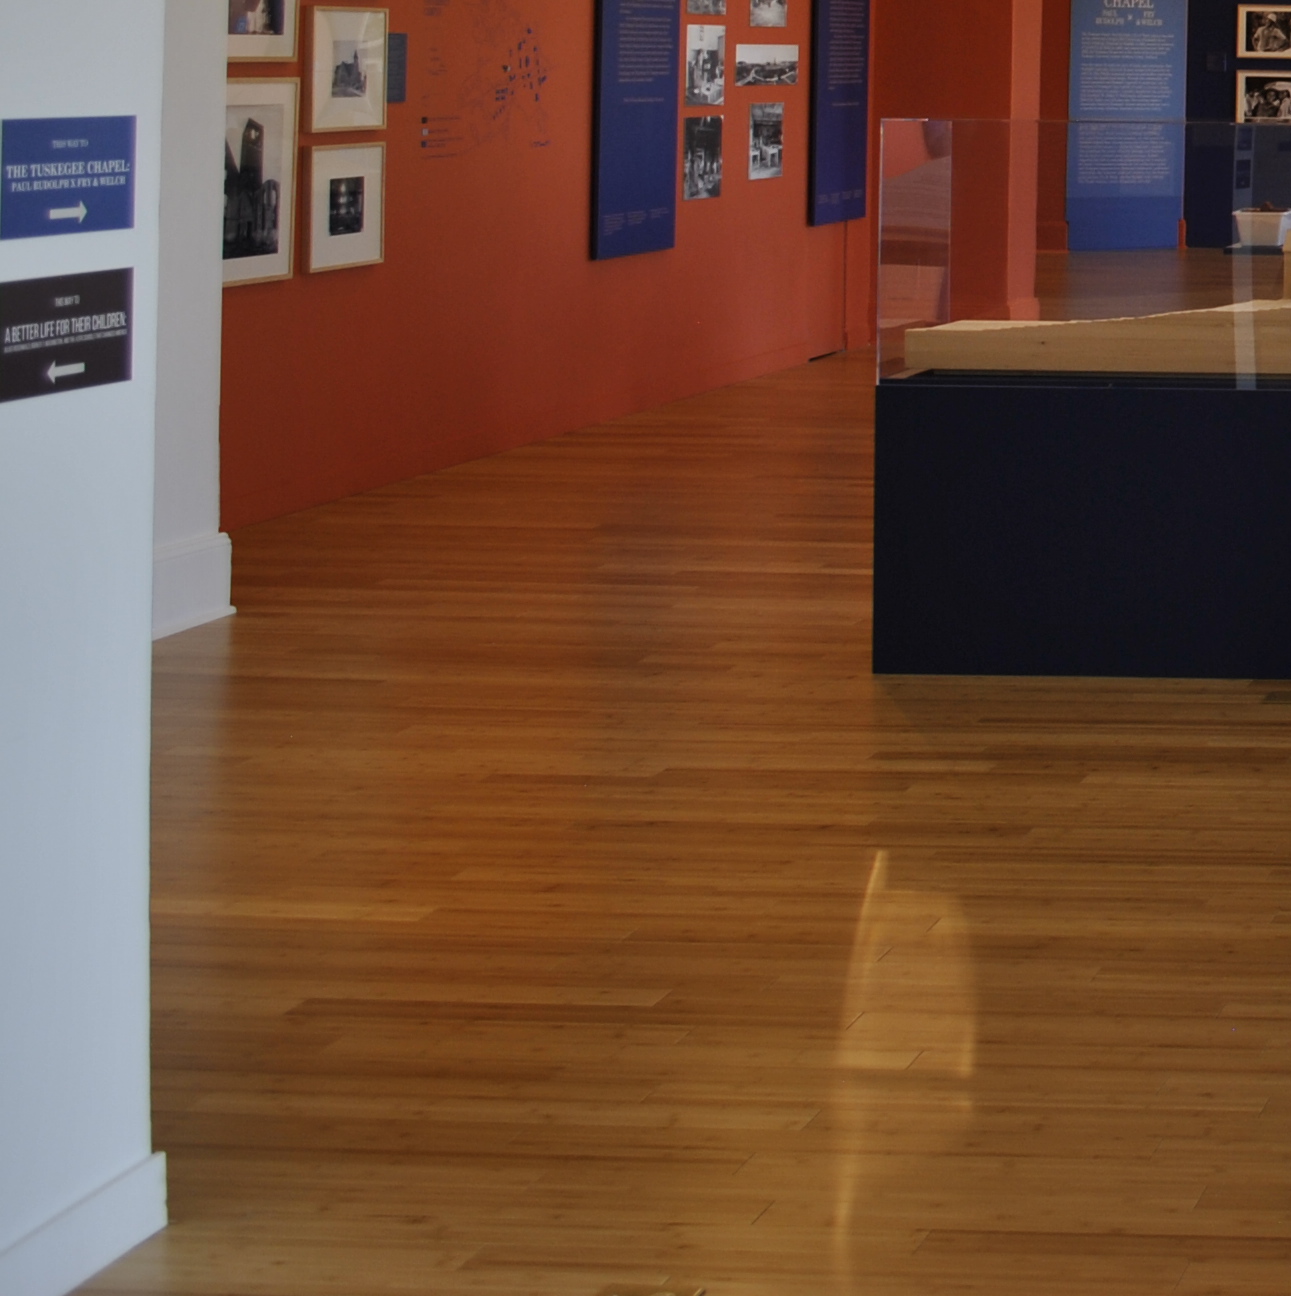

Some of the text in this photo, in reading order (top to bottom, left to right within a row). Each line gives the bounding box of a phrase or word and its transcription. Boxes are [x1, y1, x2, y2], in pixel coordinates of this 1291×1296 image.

[6, 159, 130, 179] THE TUSKEGEE CHAPEL:
[11, 181, 32, 192] PAUL
[5, 327, 11, 344] A
[11, 323, 39, 343] BETTER
[40, 320, 55, 338] LIFE
[56, 318, 70, 336] FOR
[71, 315, 91, 333] THEIR
